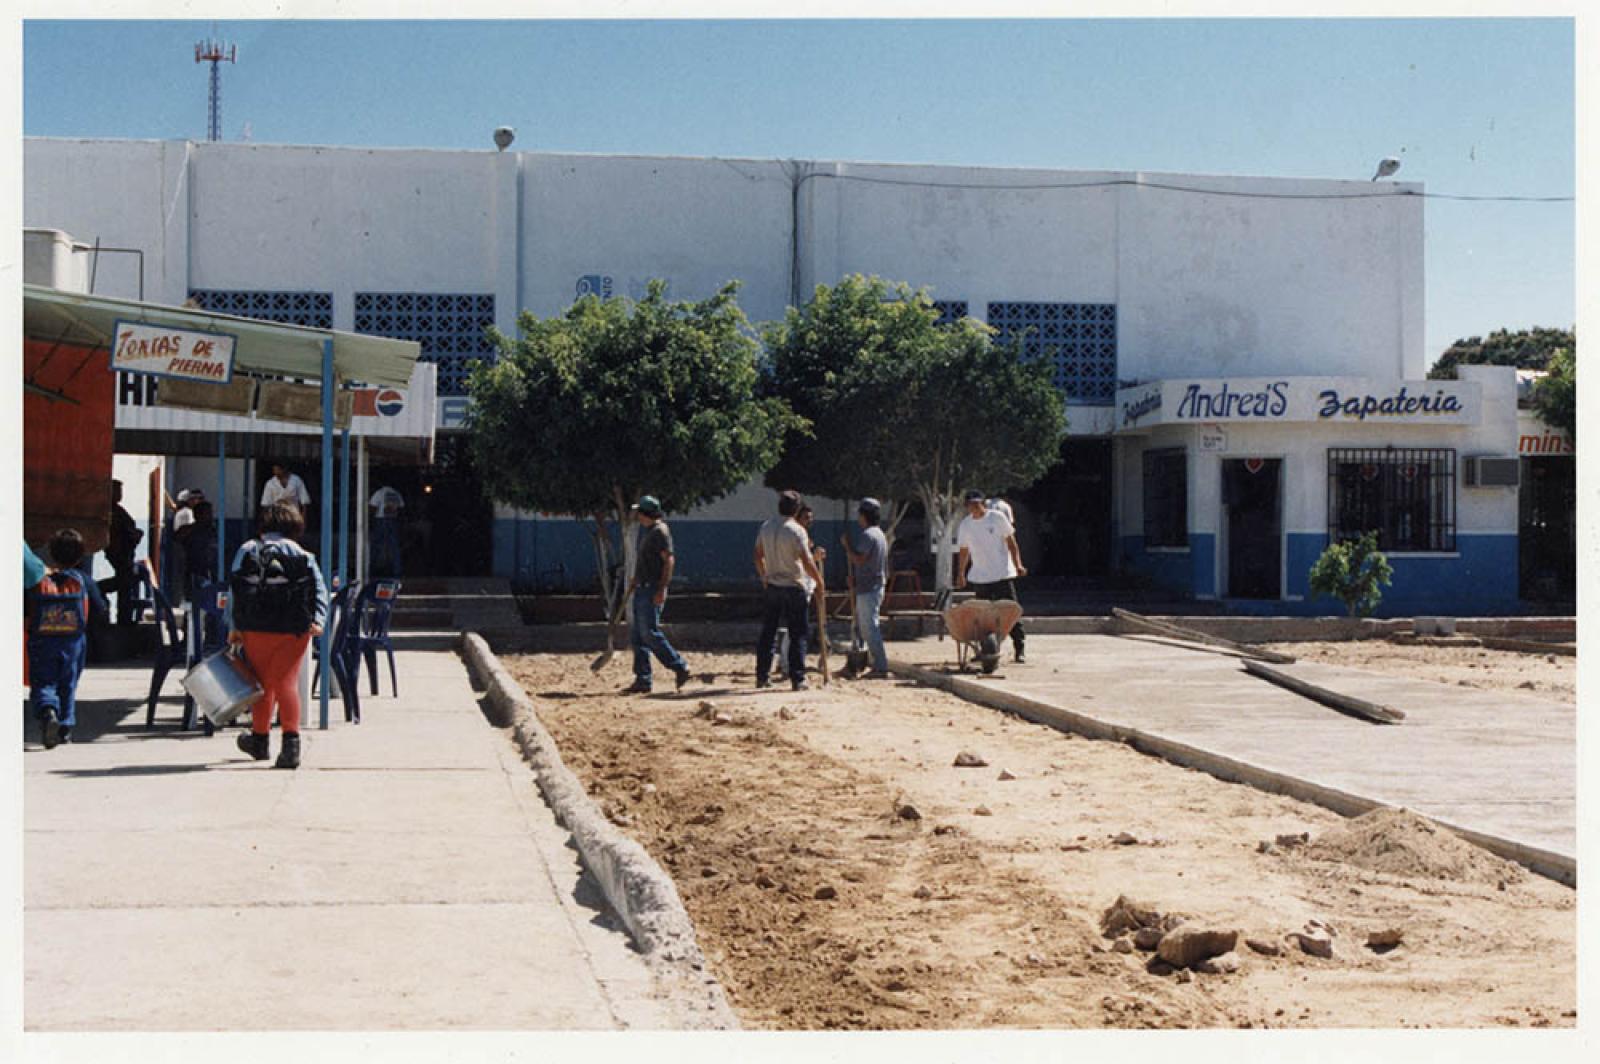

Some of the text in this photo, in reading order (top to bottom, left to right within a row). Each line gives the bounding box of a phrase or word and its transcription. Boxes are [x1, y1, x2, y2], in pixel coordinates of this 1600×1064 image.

[191, 340, 215, 357] DE
[167, 358, 225, 377] PIERNA
[1319, 387, 1462, 420] Zapateria
